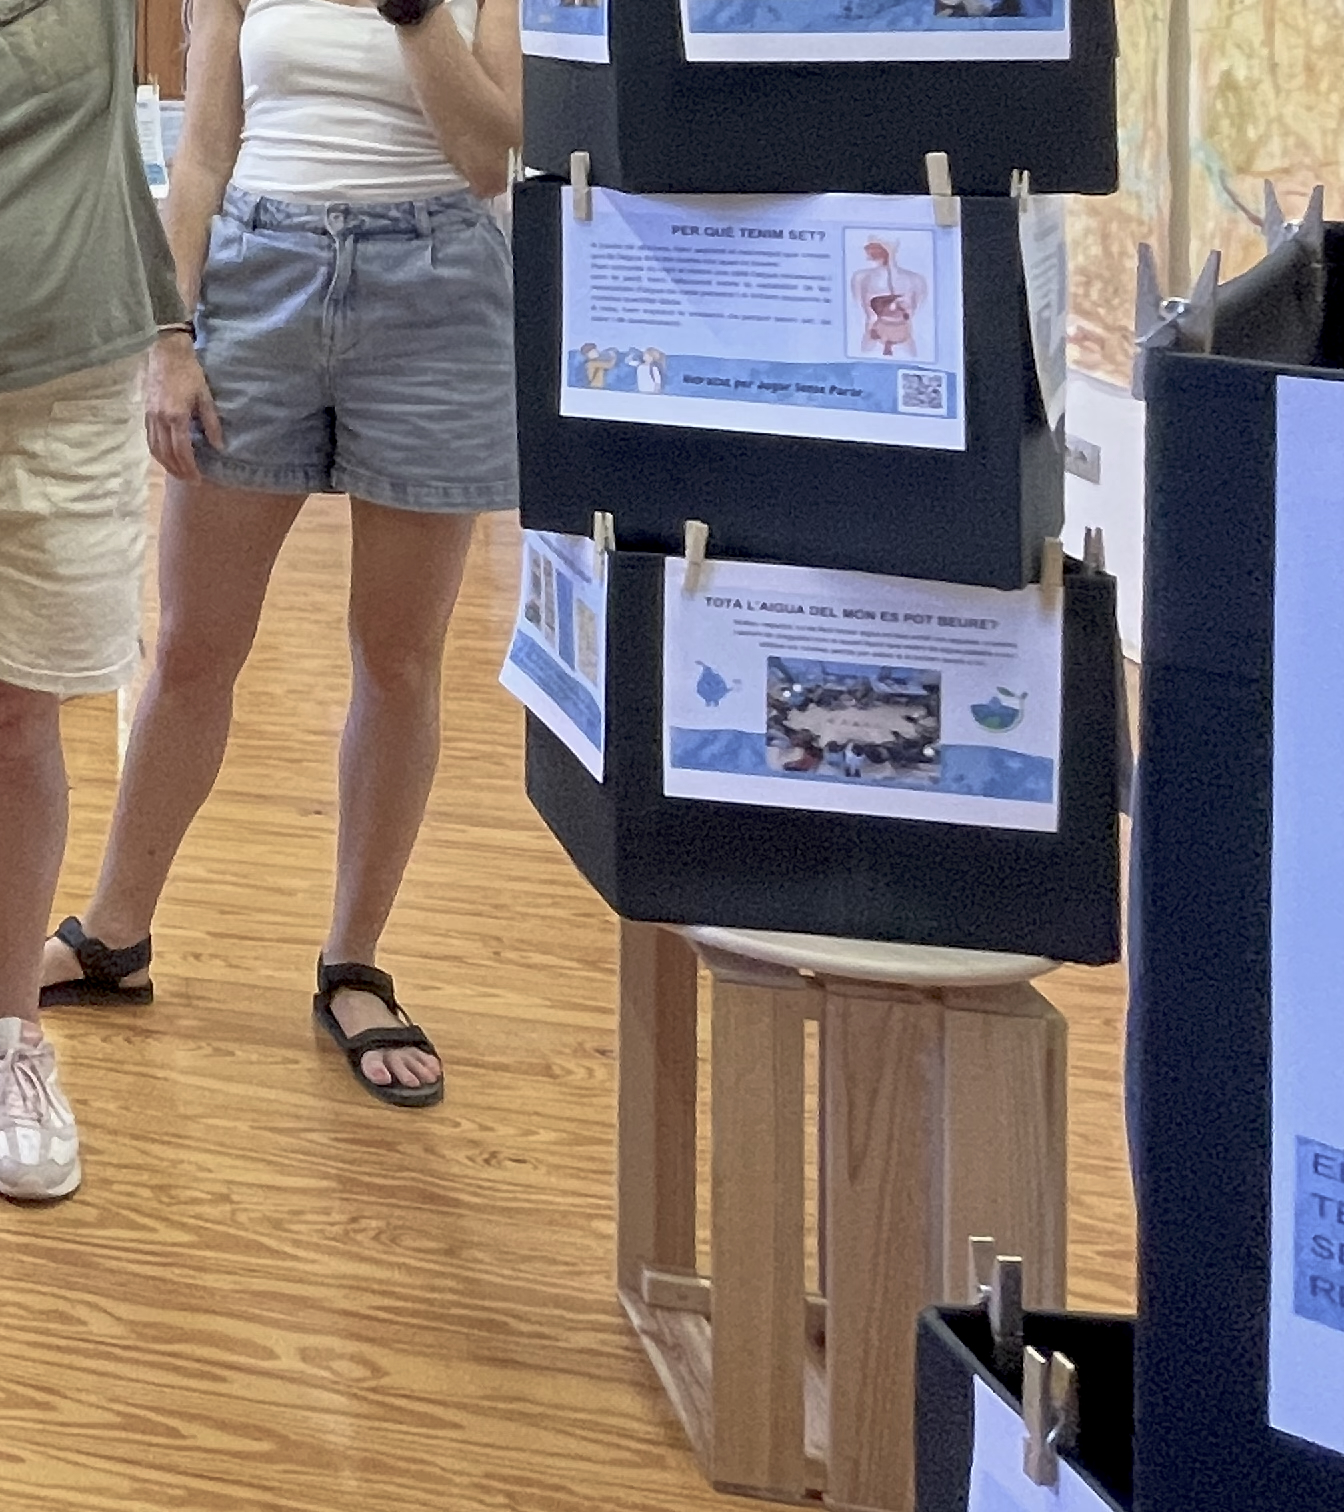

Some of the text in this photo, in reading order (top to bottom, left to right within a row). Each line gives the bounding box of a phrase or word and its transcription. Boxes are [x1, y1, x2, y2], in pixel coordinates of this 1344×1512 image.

[671, 224, 700, 236] PER
[788, 229, 826, 242] SET?
[705, 596, 743, 610] TOTA
[809, 605, 837, 618] DEL
[903, 612, 933, 624] POT
[1313, 1152, 1344, 1184] E
[1311, 1234, 1344, 1266] S
[1309, 1274, 1344, 1308] R
